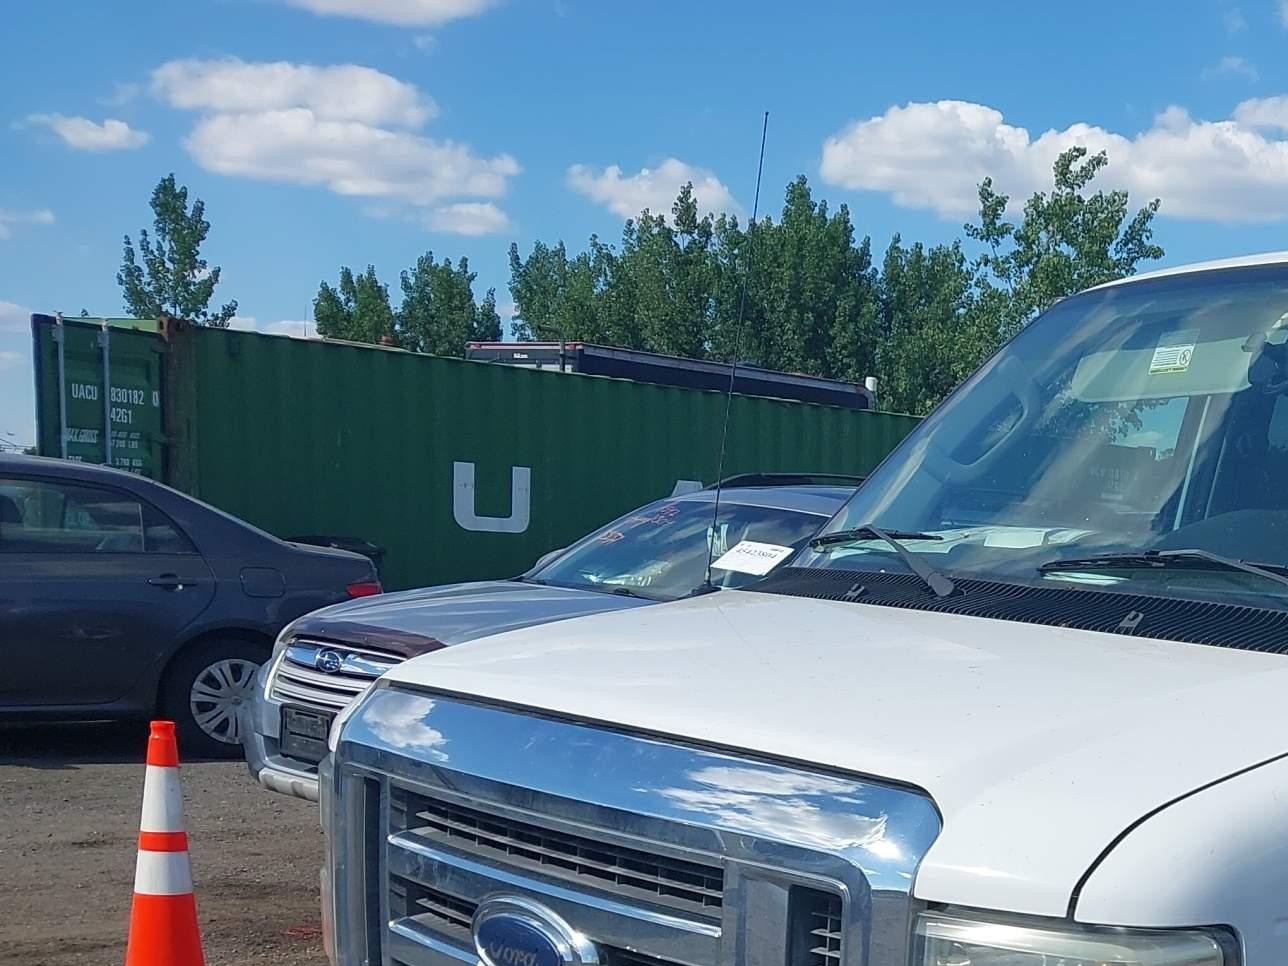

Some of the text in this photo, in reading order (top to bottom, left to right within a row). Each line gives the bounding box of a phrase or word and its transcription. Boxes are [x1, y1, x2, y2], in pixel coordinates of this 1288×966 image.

[71, 383, 160, 407] UACU 830182 0
[110, 408, 132, 424] 42G1
